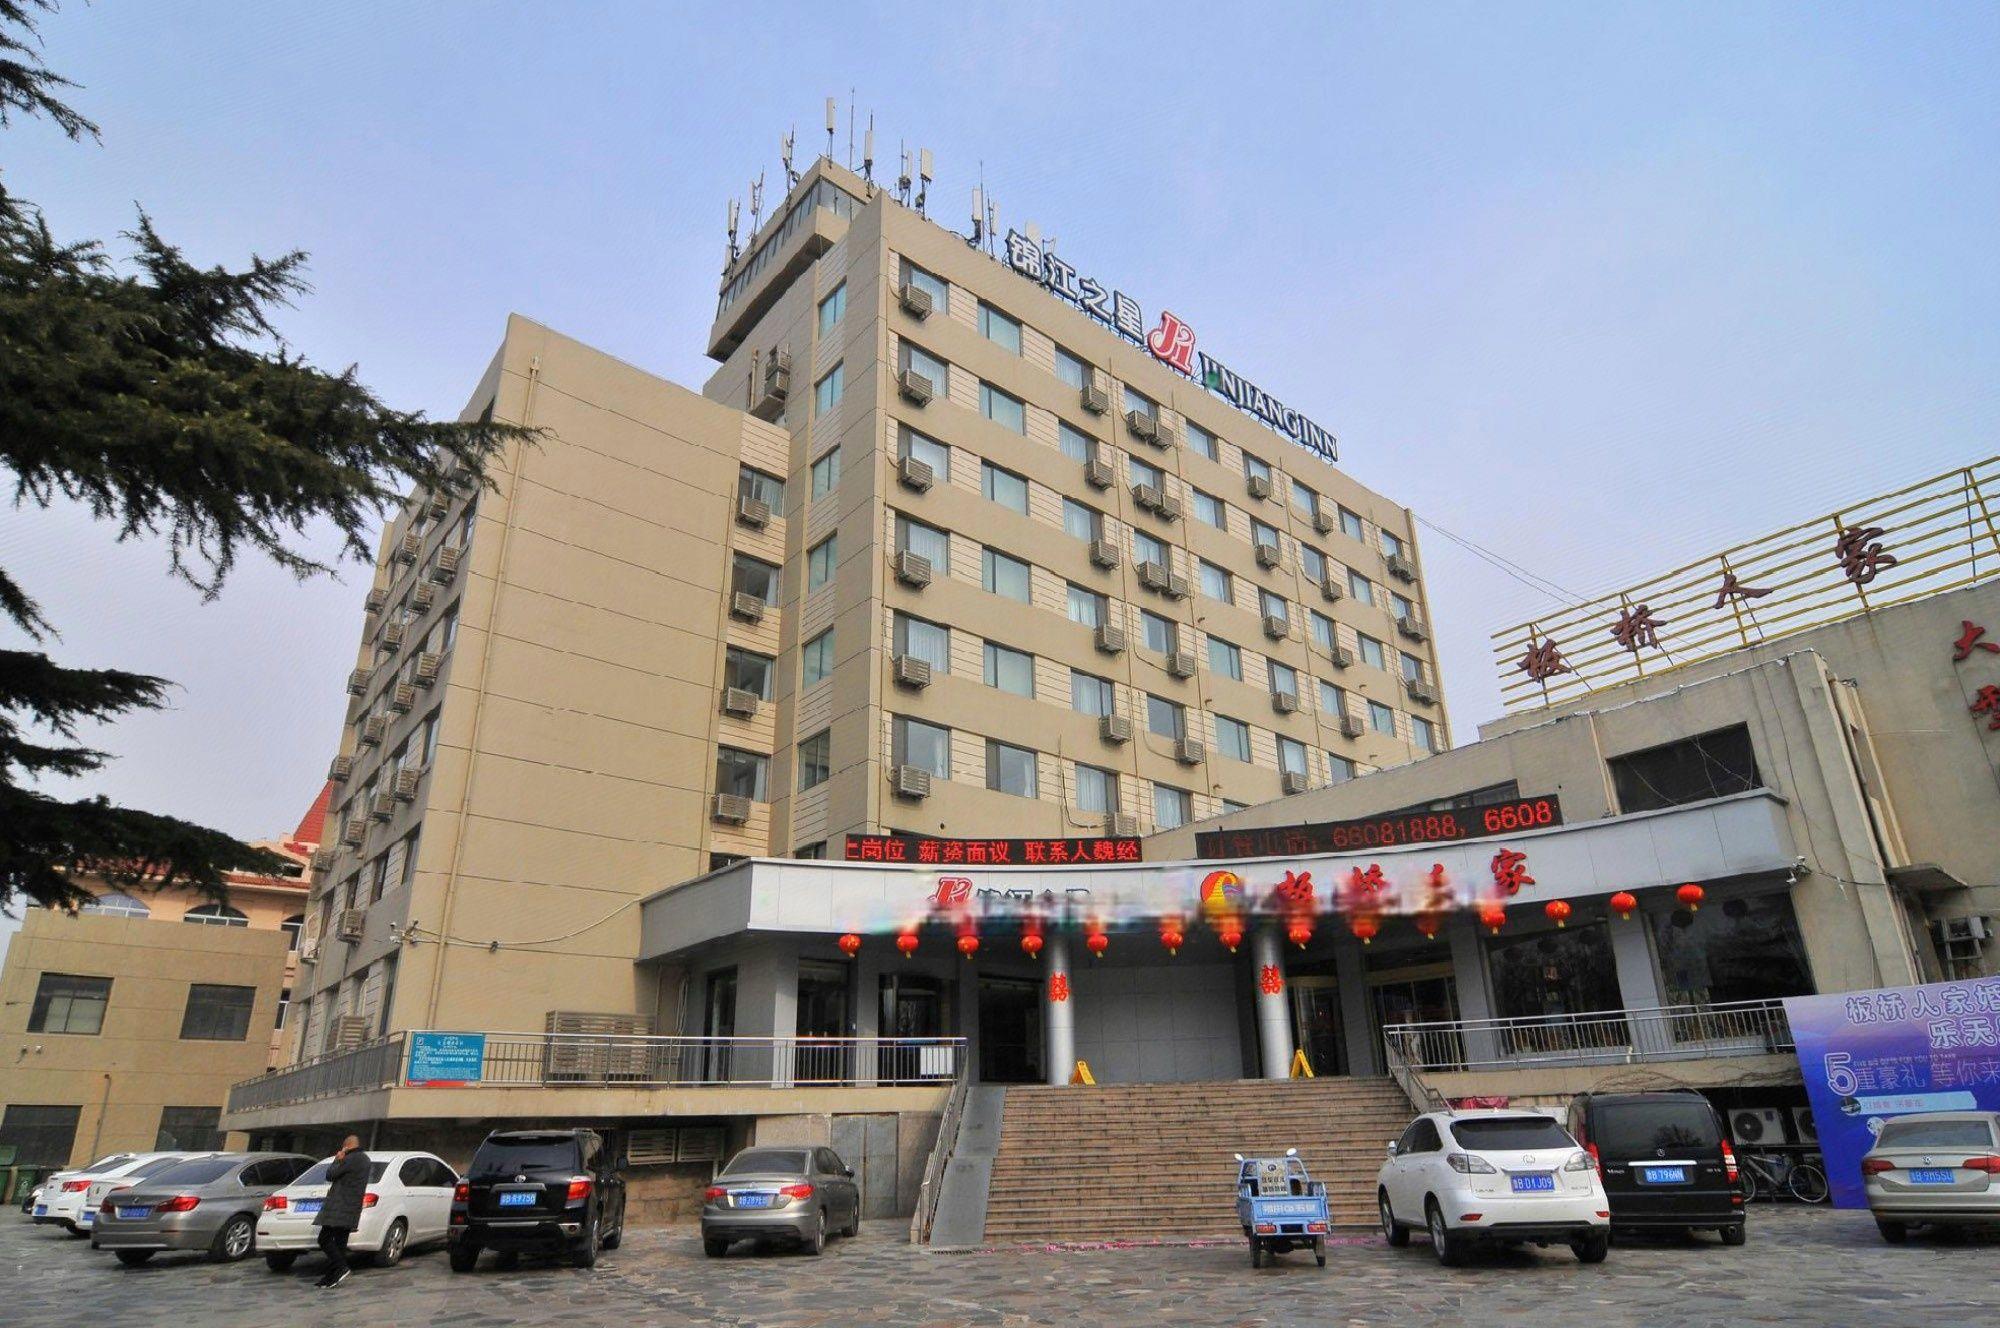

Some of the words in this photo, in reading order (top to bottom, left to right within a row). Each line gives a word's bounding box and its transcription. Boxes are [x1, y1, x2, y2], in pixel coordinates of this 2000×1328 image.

[1005, 228, 1145, 345] 锦江之星
[1484, 800, 1553, 832] 6608
[919, 840, 1011, 863] 薪资面议
[1025, 840, 1140, 862] 联系人魏经
[1929, 1017, 2000, 1049] 乐天
